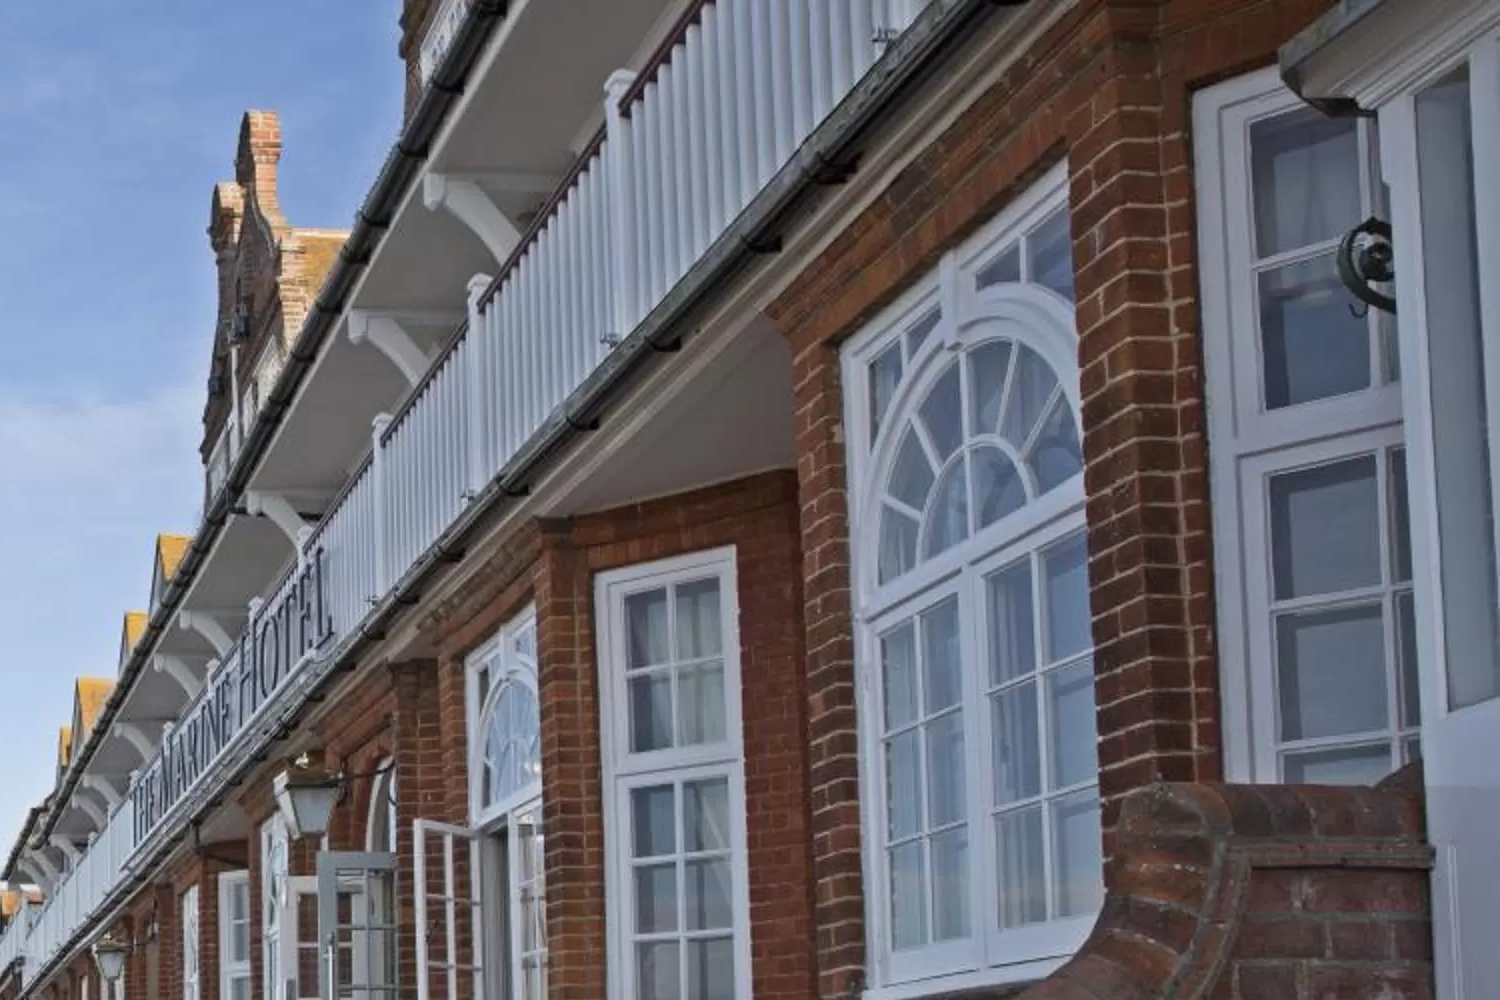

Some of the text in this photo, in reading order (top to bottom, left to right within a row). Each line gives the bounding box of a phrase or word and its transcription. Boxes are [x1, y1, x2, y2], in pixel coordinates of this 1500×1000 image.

[131, 547, 334, 848] THE MARINE HOTEL
